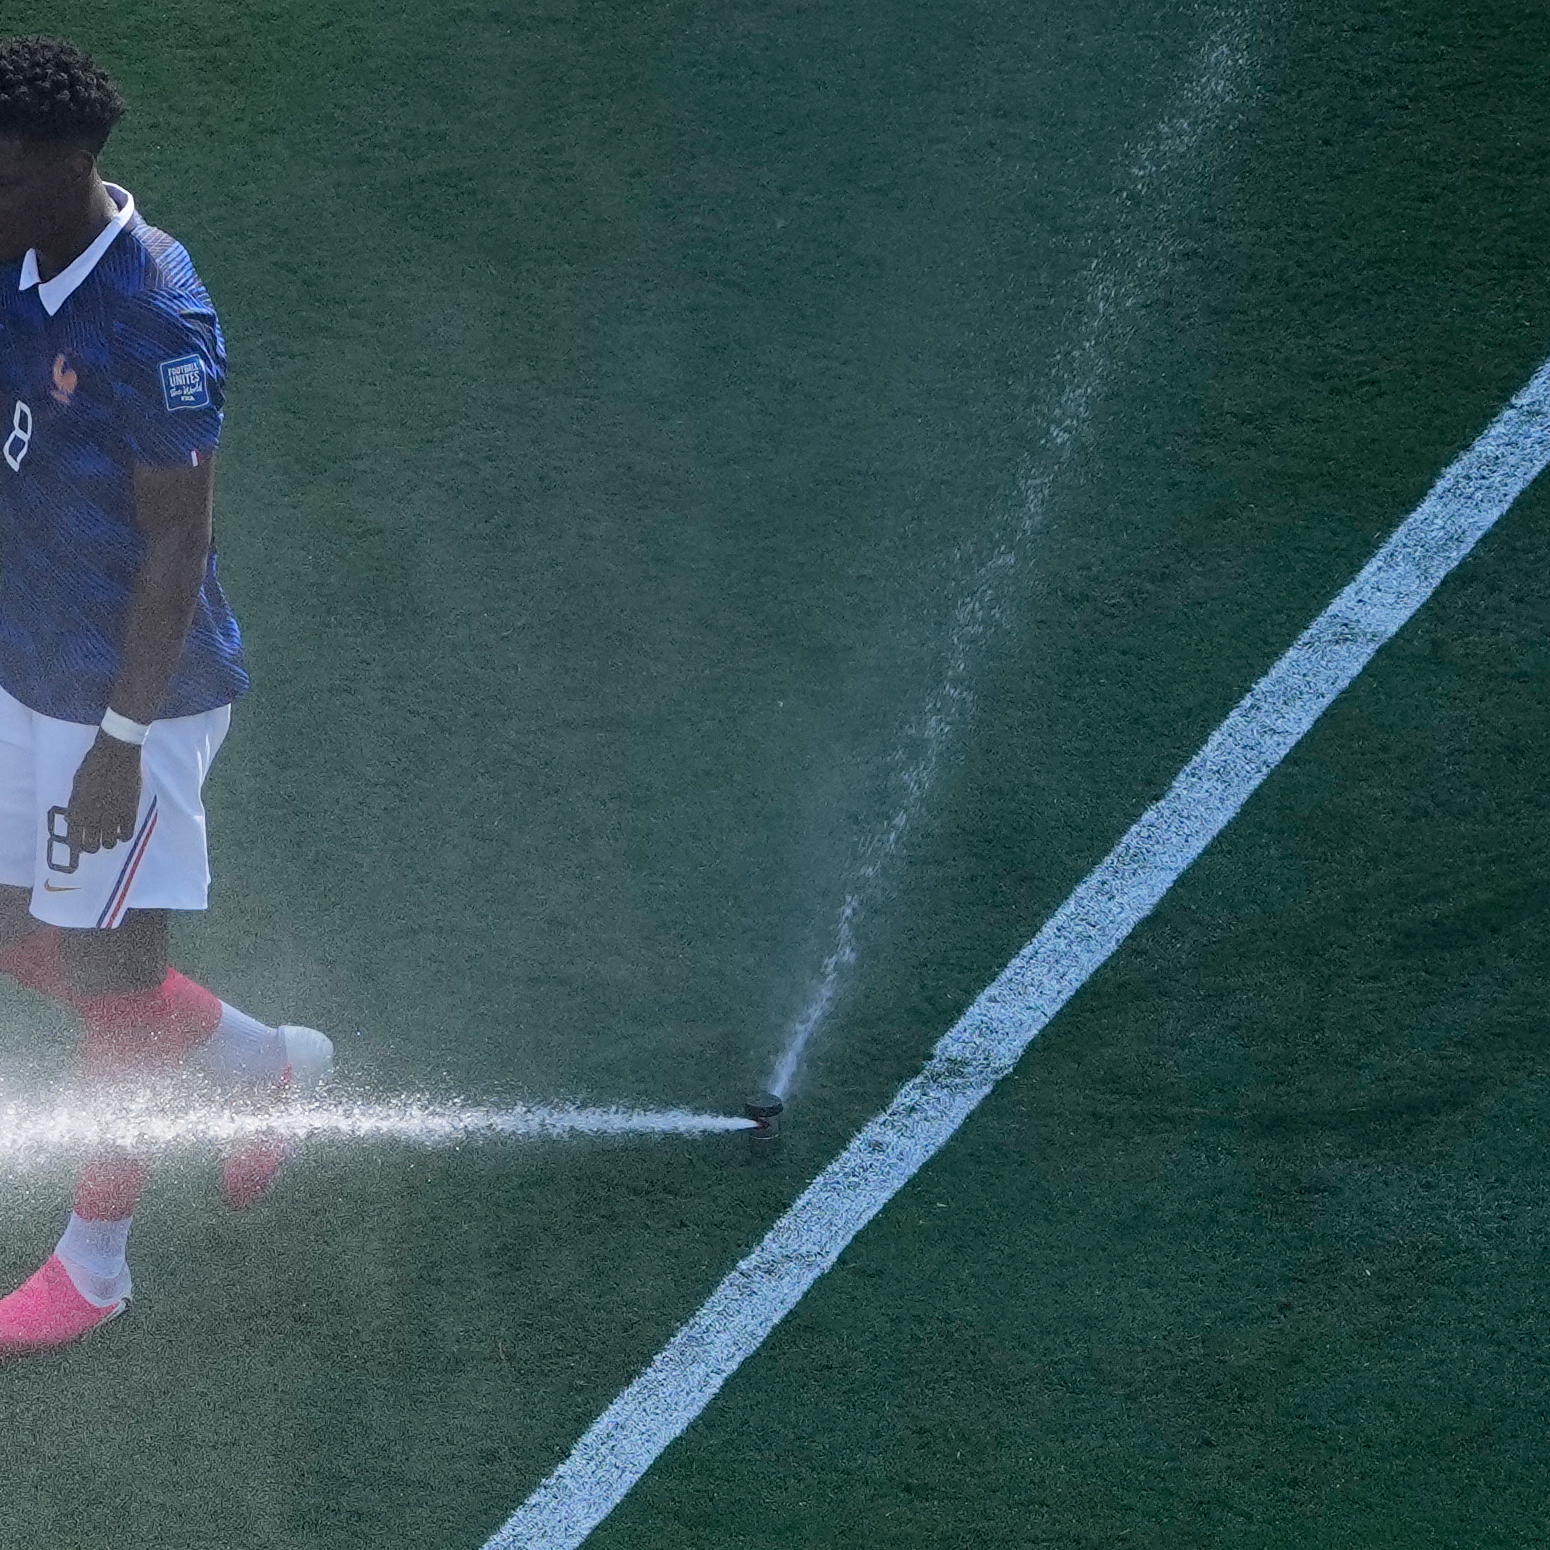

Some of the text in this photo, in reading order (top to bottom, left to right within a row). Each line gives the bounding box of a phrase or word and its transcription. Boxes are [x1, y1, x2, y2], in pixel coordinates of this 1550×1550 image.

[169, 371, 200, 387] UNITES
[3, 400, 32, 472] 8
[47, 805, 79, 874] 8
